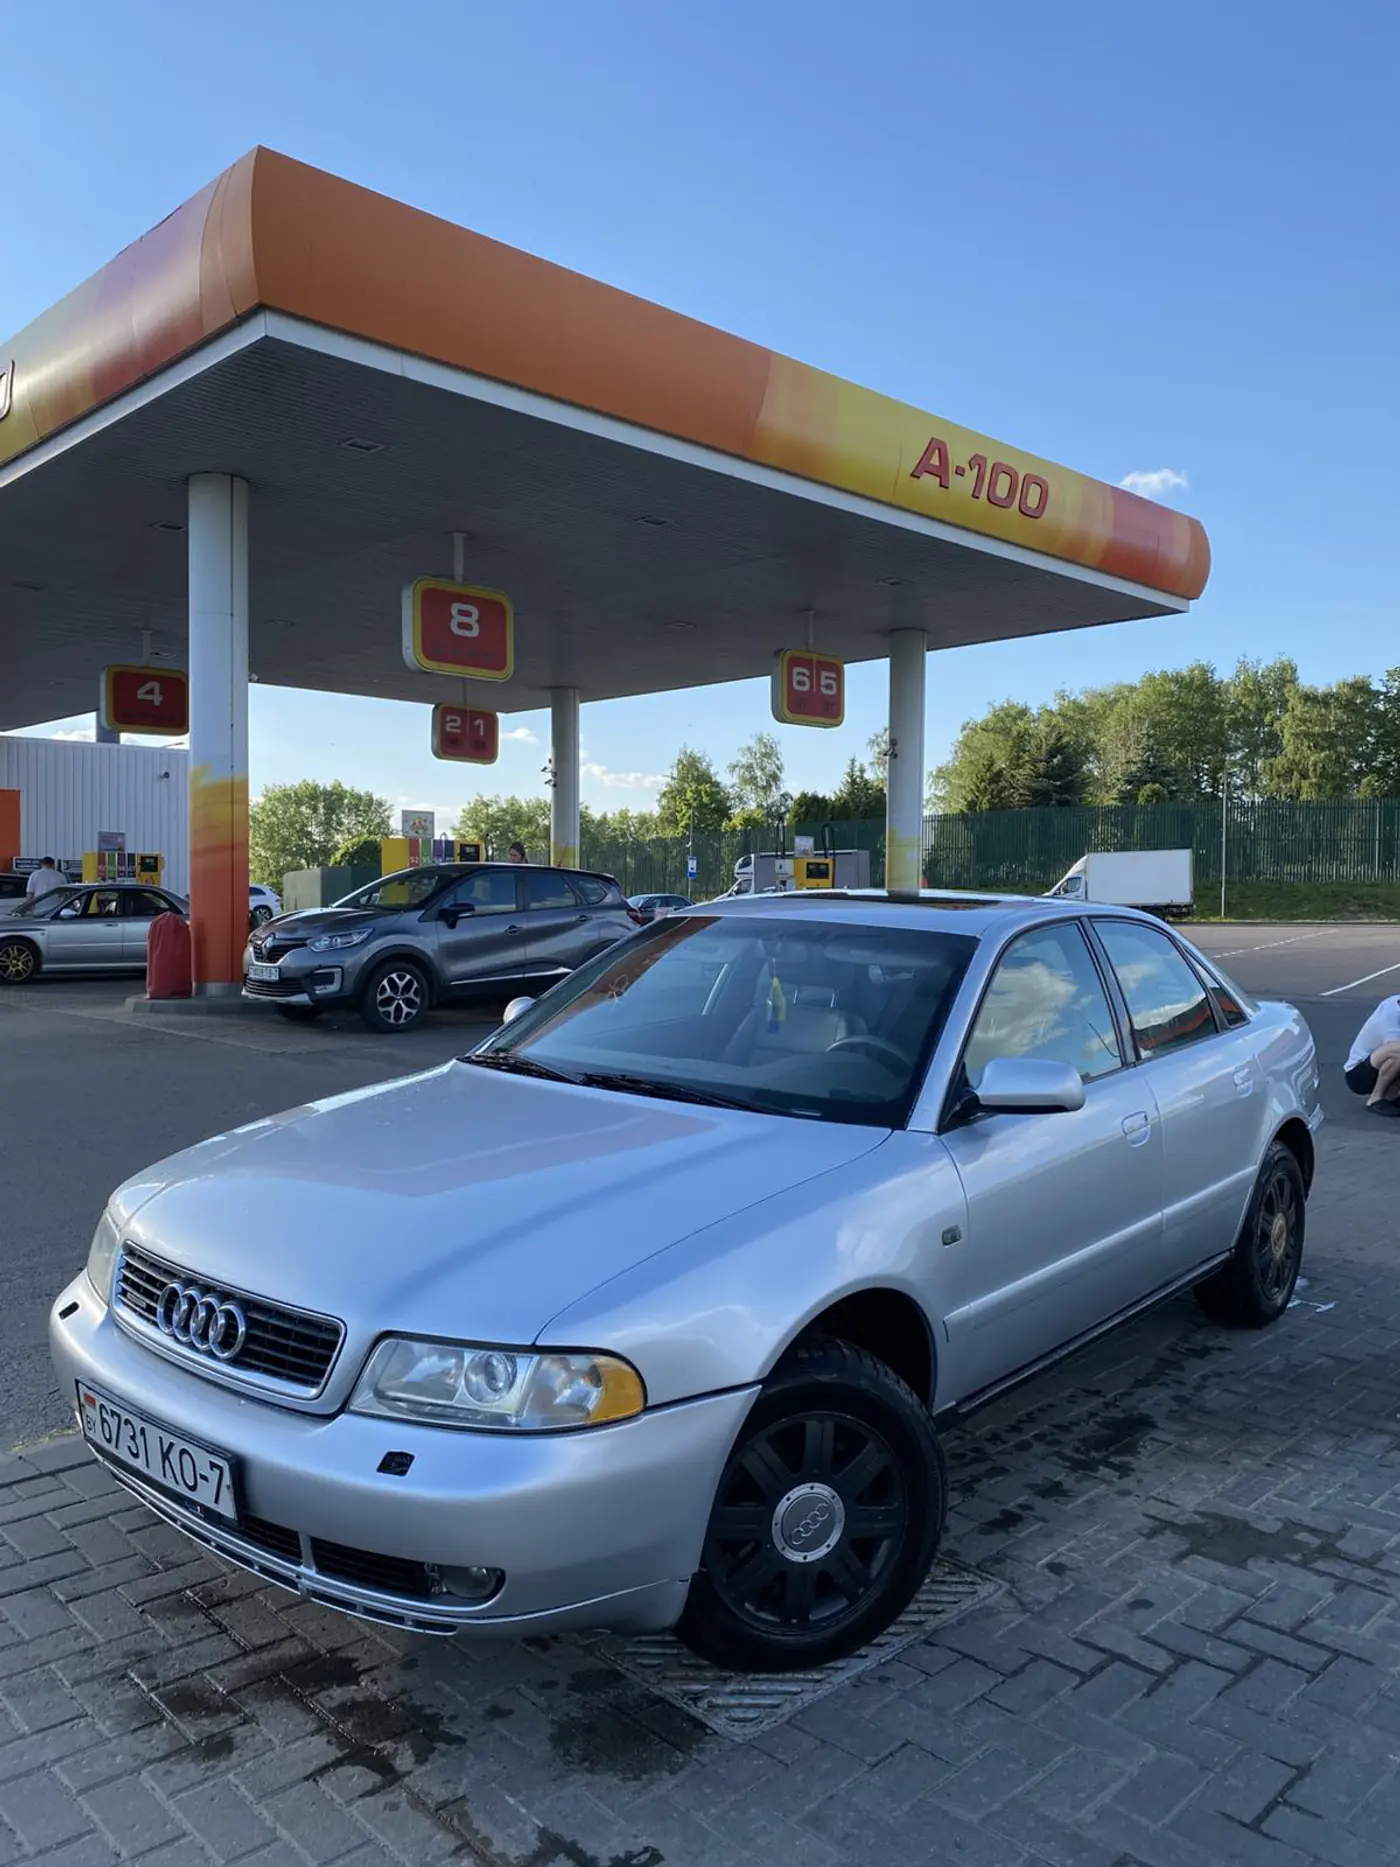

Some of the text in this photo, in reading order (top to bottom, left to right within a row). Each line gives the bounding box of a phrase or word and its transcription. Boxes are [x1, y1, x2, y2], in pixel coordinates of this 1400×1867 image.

[910, 436, 1049, 519] A-100
[449, 602, 480, 638] 8
[136, 681, 163, 706] 4
[792, 666, 837, 695] 6 5
[445, 715, 485, 736] 2 1
[86, 1414, 97, 1433] BY
[99, 1402, 224, 1504] 6731 KO-7
